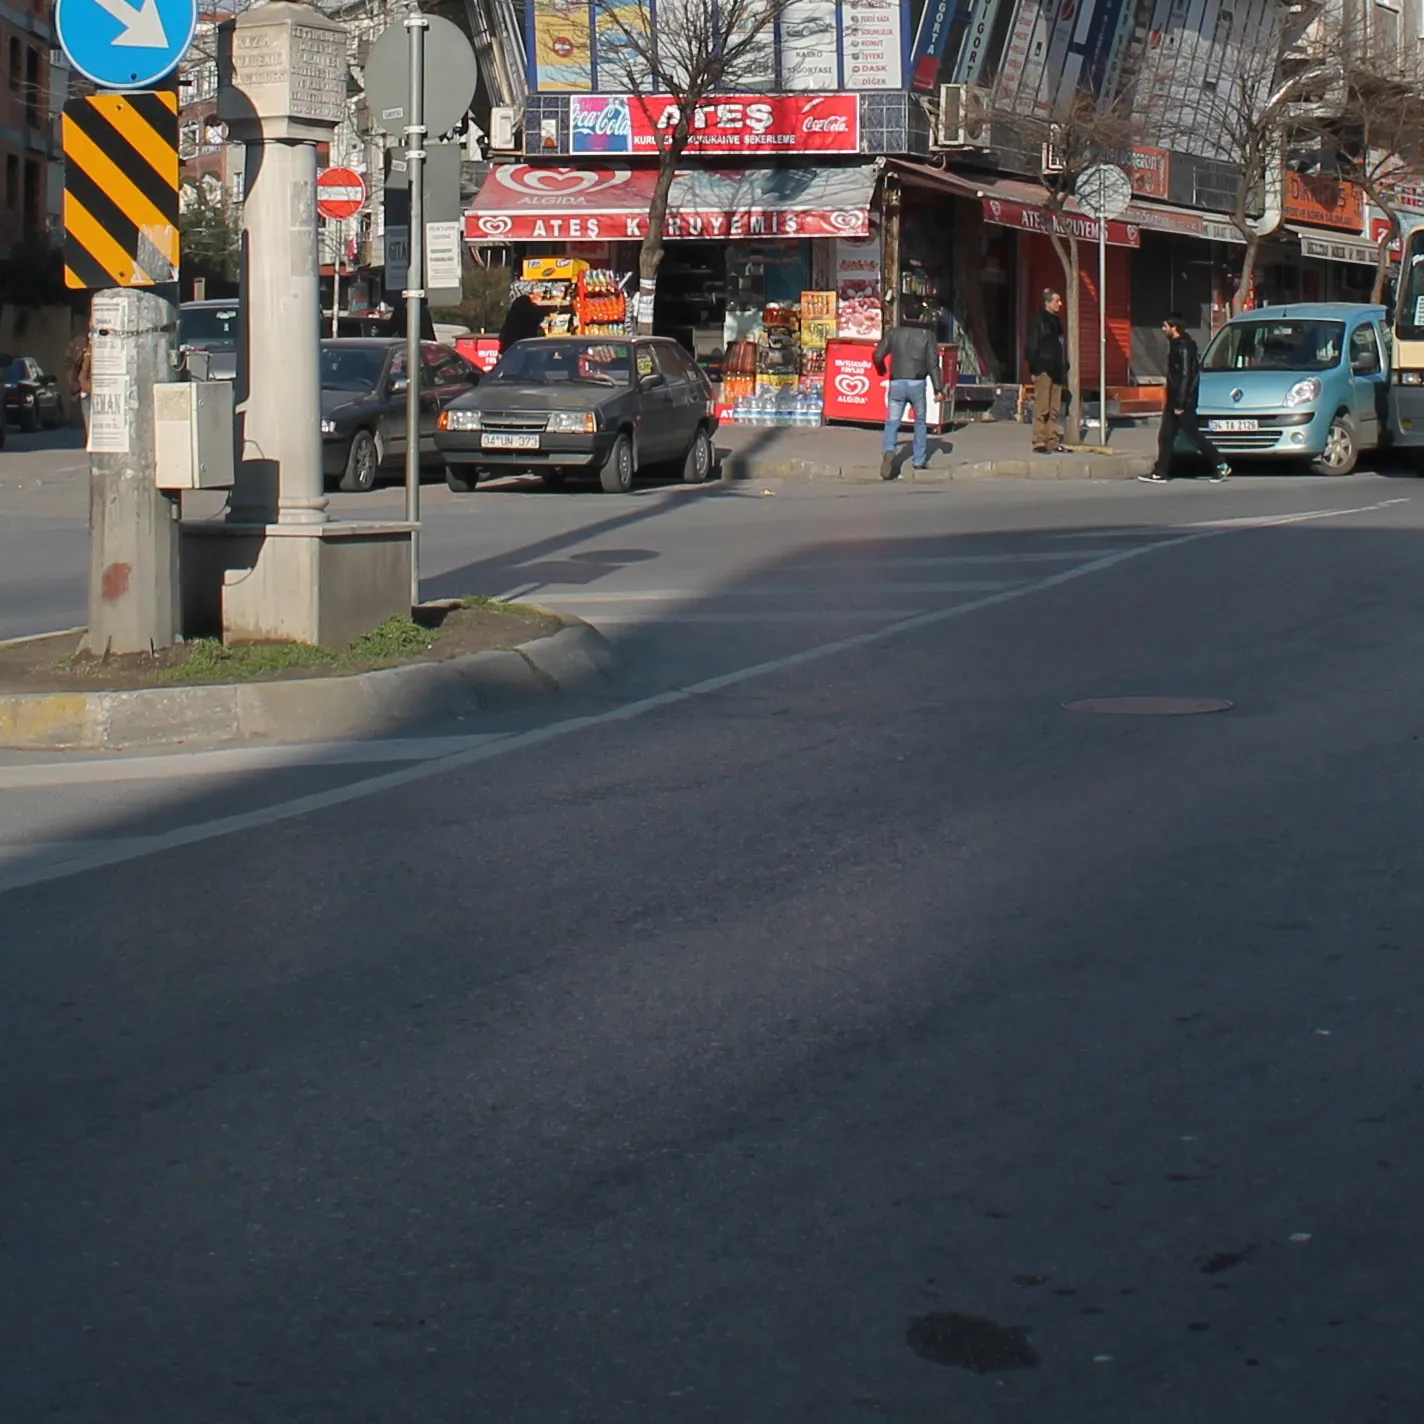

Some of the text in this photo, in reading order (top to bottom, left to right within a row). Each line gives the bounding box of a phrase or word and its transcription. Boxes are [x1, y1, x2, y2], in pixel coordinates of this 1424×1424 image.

[861, 52, 884, 61] İŞYERİ
[862, 77, 887, 86] DİĞER
[656, 103, 774, 134] ATEŞ
[516, 195, 588, 206] ALGIDA
[532, 211, 799, 240] ATEŞ KRUYEMİŞ
[1052, 214, 1108, 240] KRUYEMŞ
[483, 435, 495, 445] 34
